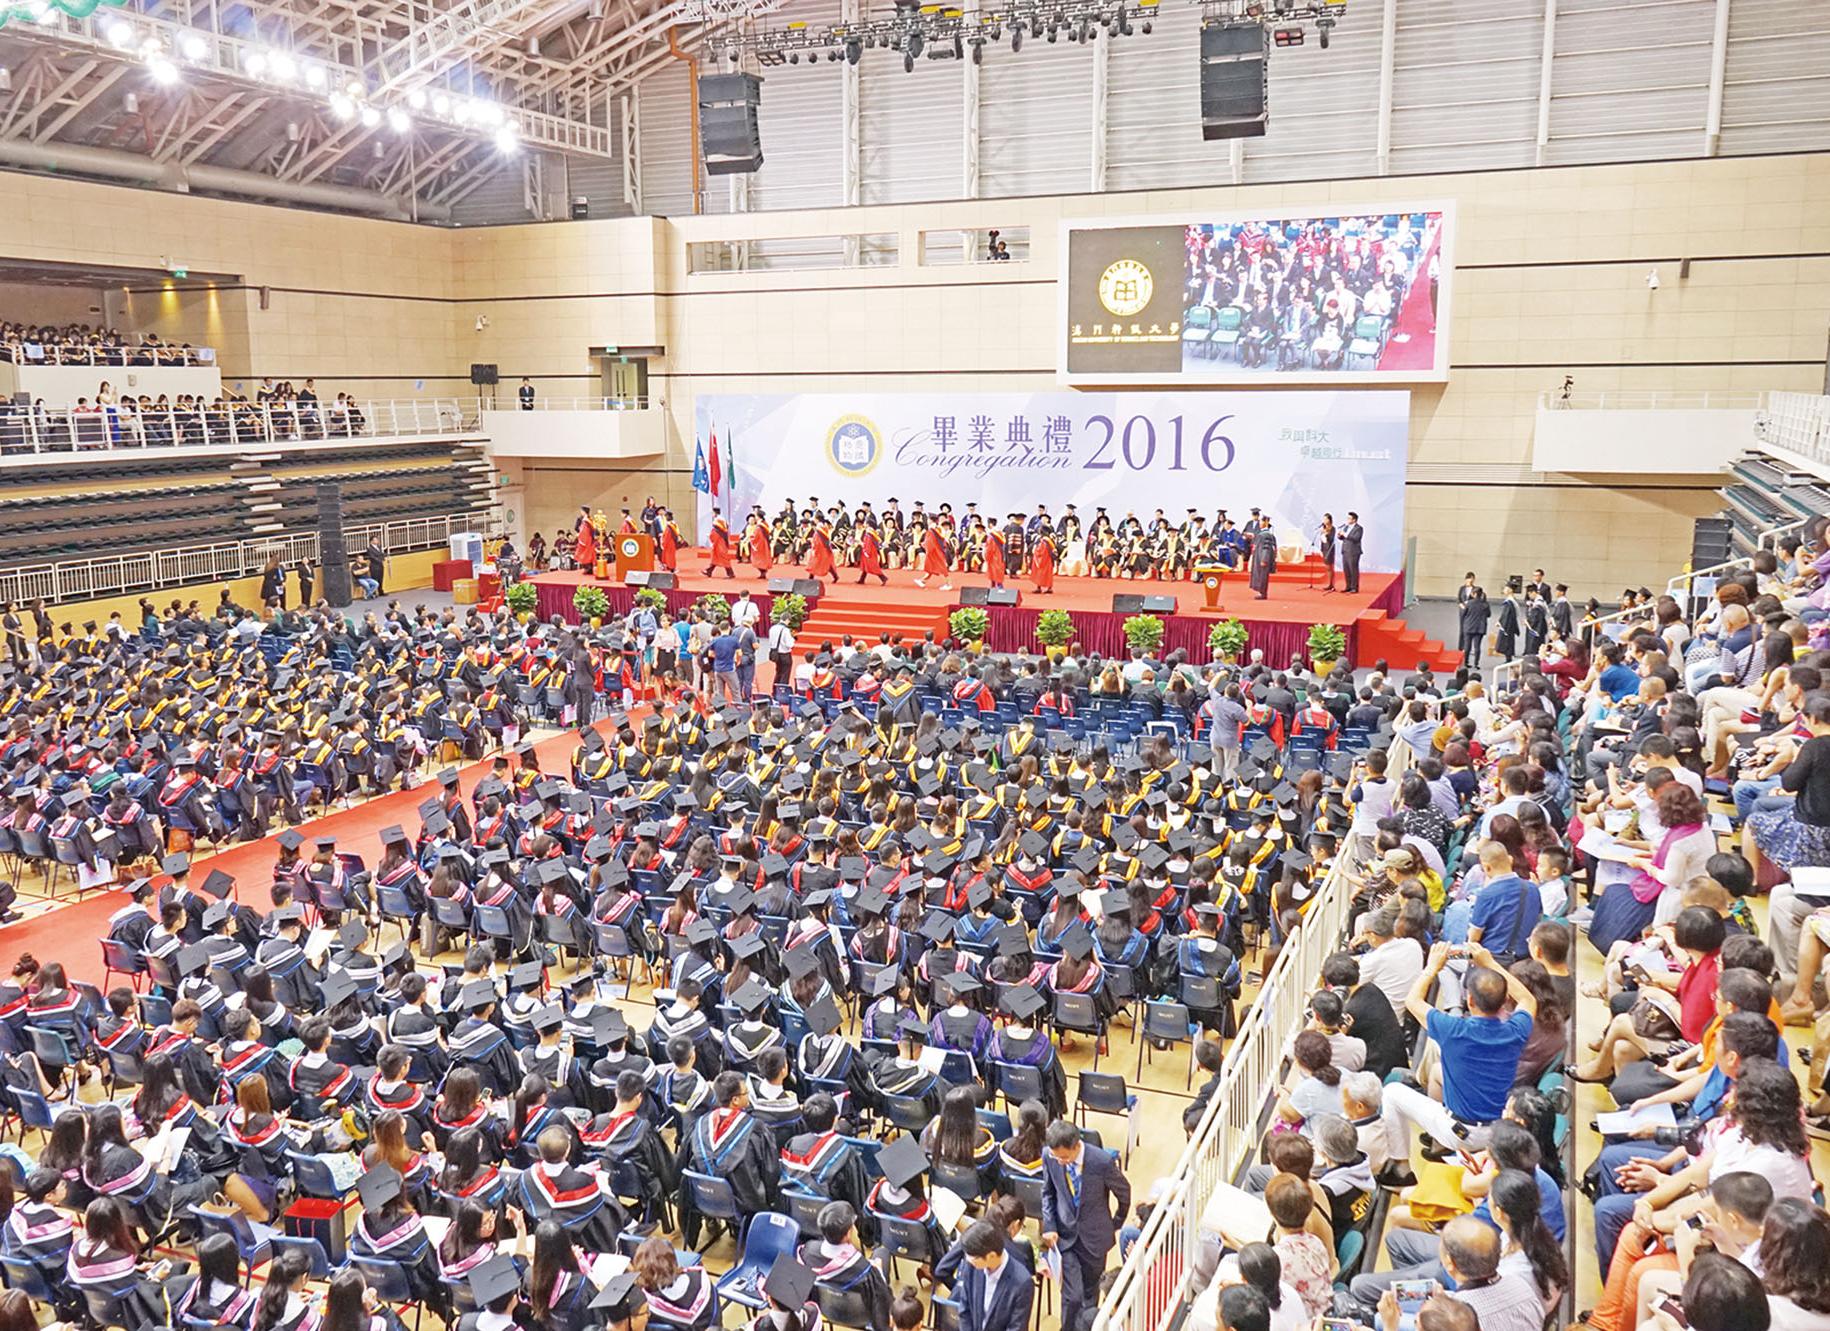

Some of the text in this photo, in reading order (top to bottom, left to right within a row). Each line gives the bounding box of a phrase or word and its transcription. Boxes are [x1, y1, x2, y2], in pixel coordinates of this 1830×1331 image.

[891, 426, 1073, 480] Congregation
[931, 415, 1073, 454] 畢業典禮
[1083, 414, 1236, 472] 2016
